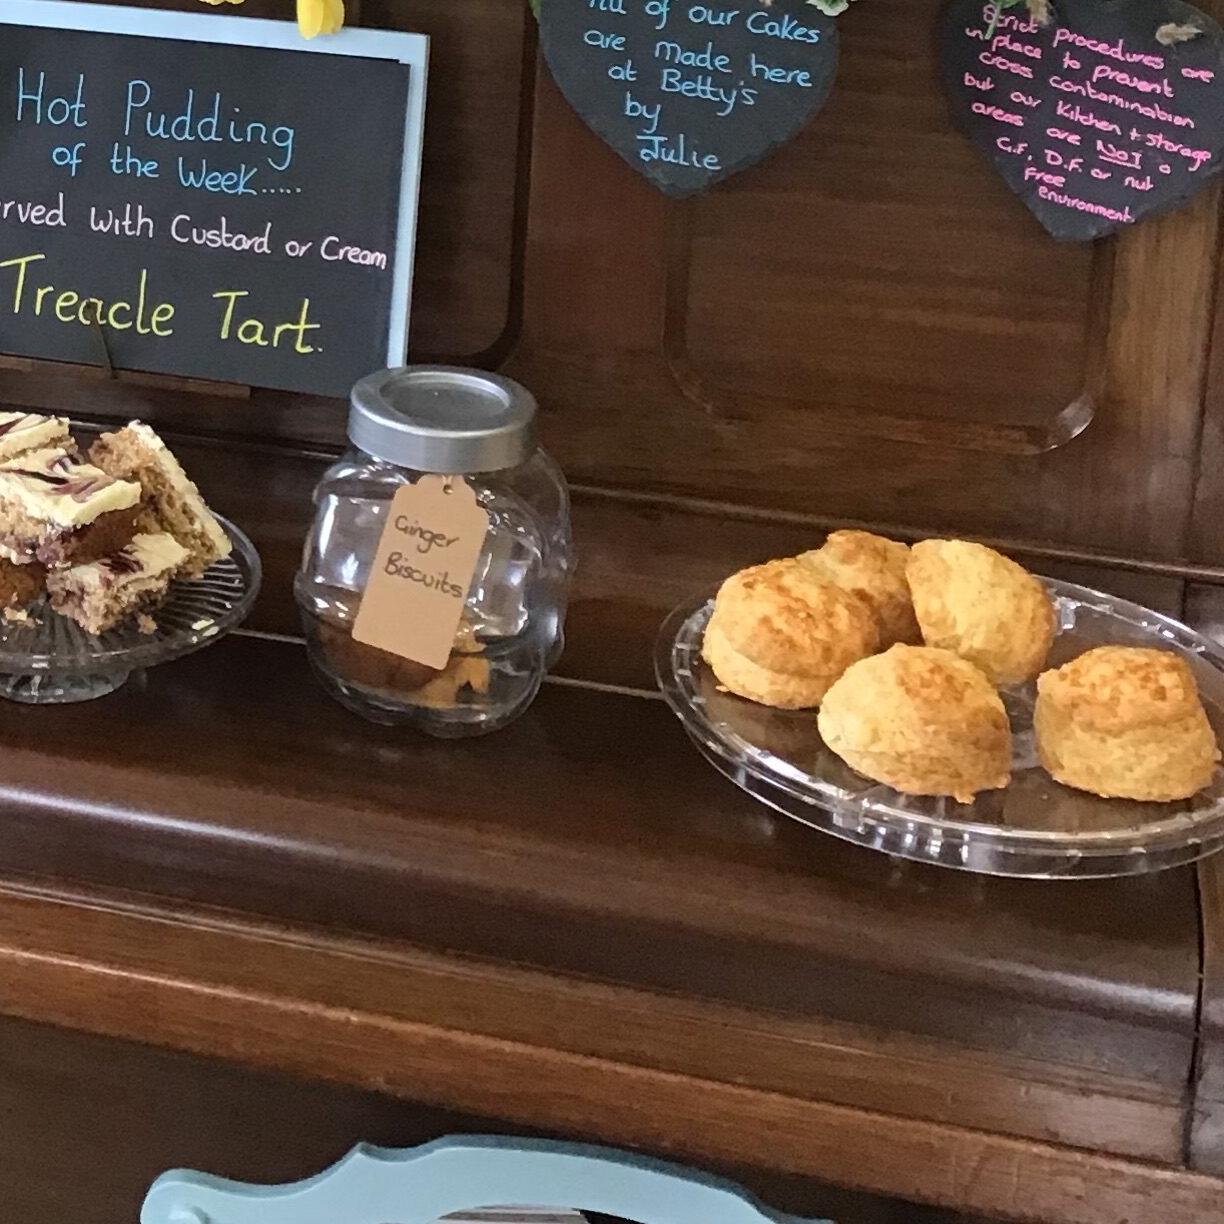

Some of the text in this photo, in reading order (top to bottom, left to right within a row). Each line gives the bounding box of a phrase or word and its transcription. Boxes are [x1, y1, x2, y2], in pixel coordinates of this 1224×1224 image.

[688, 6, 740, 26] our
[746, 11, 821, 43] Cakes
[583, 30, 626, 51] are
[751, 53, 813, 88] here
[1063, 51, 1081, 69] to
[1181, 67, 1215, 83] are
[608, 59, 759, 116] at Betty's
[963, 72, 995, 91] but
[1010, 91, 1042, 108] our
[16, 67, 295, 171] Hot Pudding
[625, 91, 662, 134] by
[636, 133, 722, 170] Julie
[971, 103, 1024, 127] areas
[1046, 127, 1082, 146] are
[1159, 164, 1171, 175] a
[52, 142, 86, 176] of
[110, 142, 160, 178] the
[1090, 168, 1112, 180] or
[1124, 175, 1154, 191] nut
[171, 214, 271, 255] Custard
[285, 239, 312, 257] or
[320, 236, 387, 270] Cream
[0, 253, 324, 354] Treacle Tart.
[394, 515, 459, 553] Ginger
[384, 551, 463, 598] Biscuits
